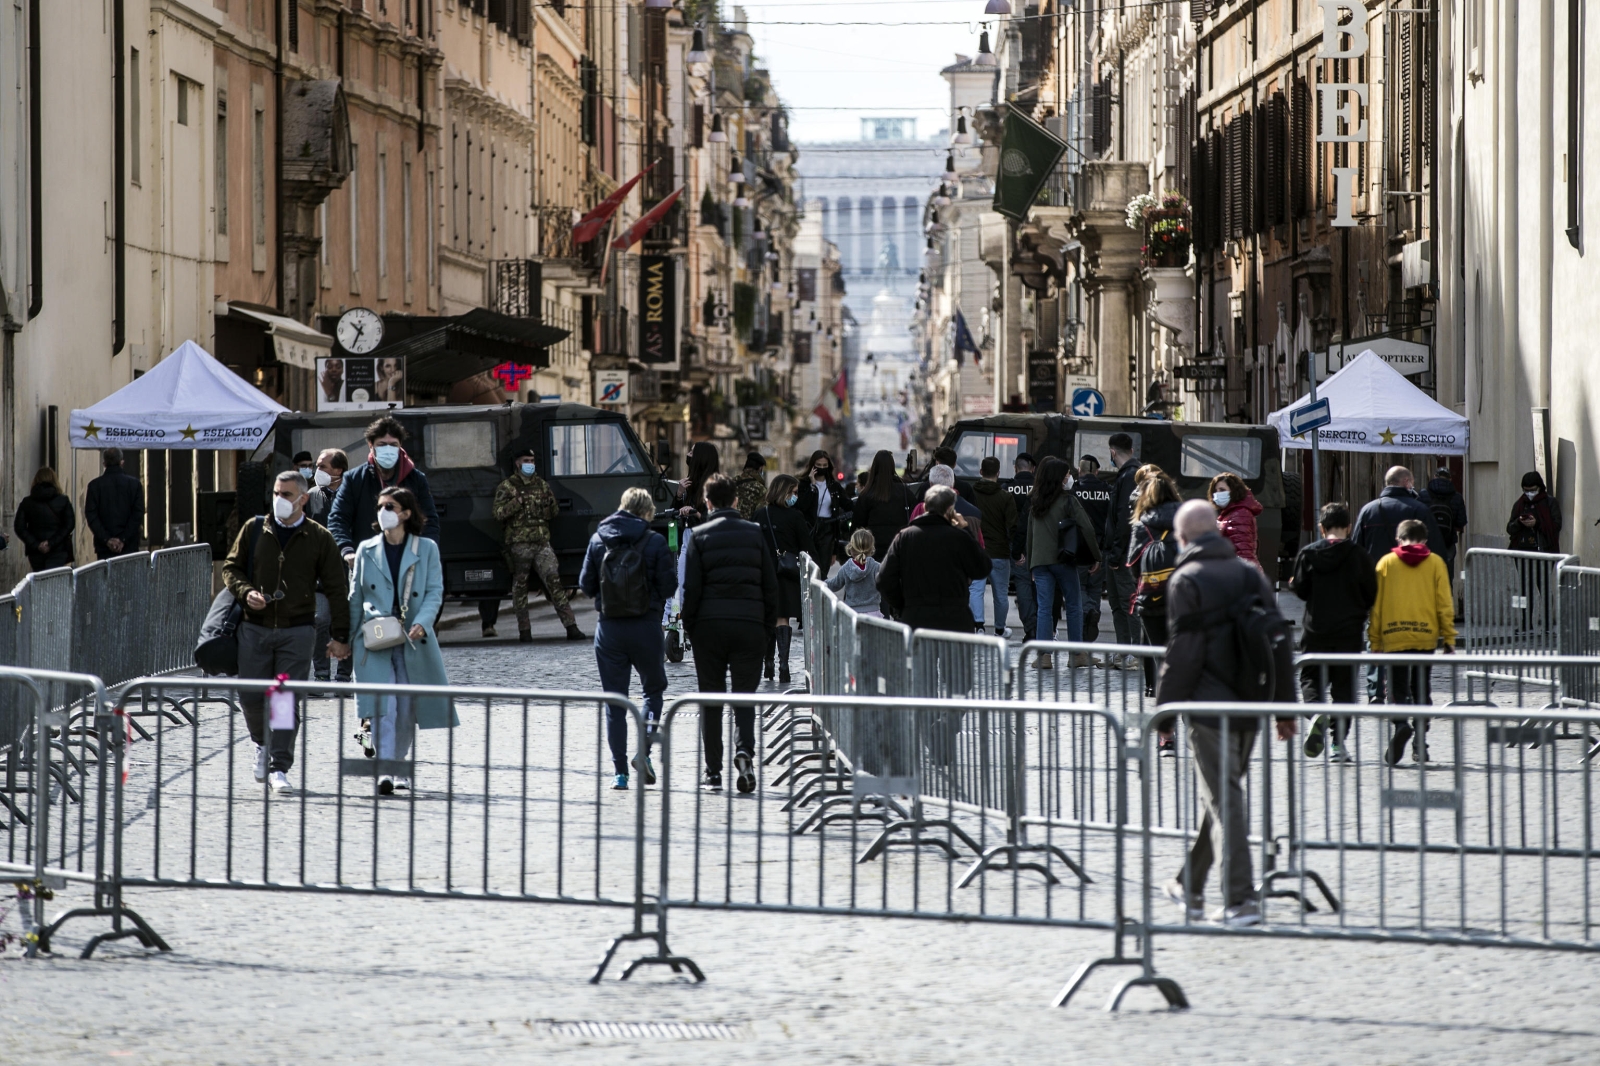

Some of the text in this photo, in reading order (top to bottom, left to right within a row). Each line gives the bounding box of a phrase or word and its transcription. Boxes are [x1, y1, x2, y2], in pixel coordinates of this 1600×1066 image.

[646, 262, 663, 322] ROMA
[105, 427, 166, 438] ESERCITO
[203, 427, 263, 437] ESERCITO
[1319, 430, 1367, 440] SERCITO
[1400, 433, 1456, 444] ESERCITO
[1008, 485, 1034, 495] POLIZ
[1075, 490, 1110, 500] POLIZIA
